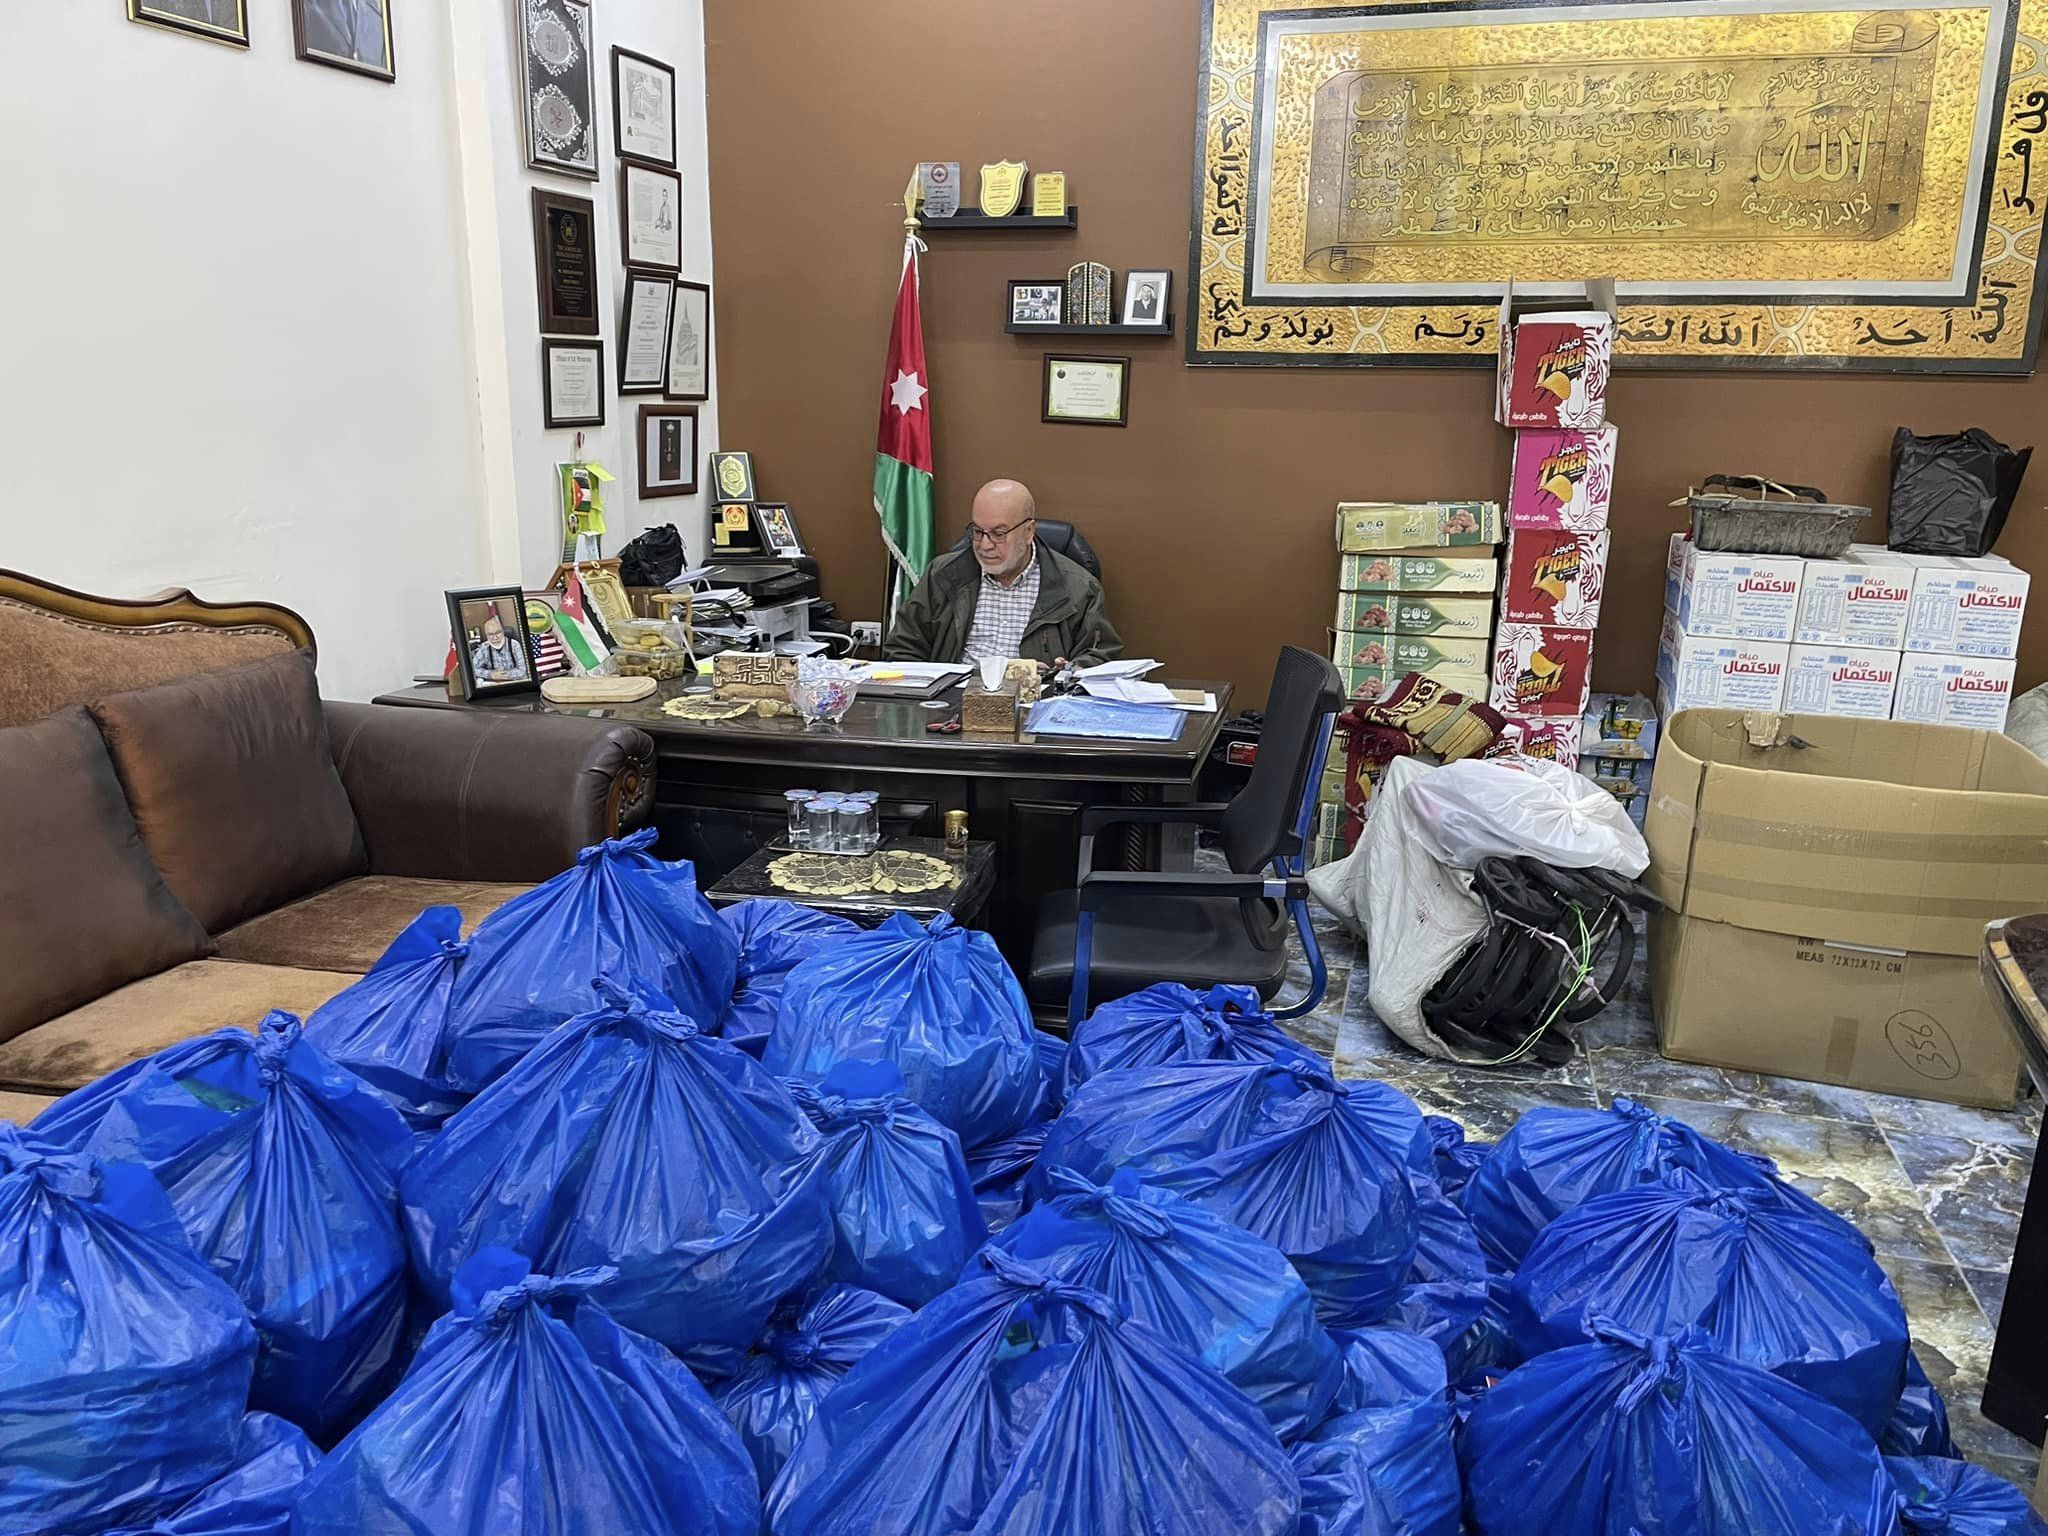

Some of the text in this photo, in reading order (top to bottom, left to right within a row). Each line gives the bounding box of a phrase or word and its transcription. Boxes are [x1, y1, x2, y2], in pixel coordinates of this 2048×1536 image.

[1757, 99, 1876, 184] الله
[1970, 275, 2018, 344] الله
[1214, 309, 1334, 347] يولد ولم
[1414, 312, 1495, 347] ولم
[1700, 312, 1760, 347] الله
[1852, 306, 1956, 346] أحد
[1556, 338, 1581, 353] تايجر
[1535, 346, 1586, 389] TIGER
[1558, 443, 1582, 457] تايجر
[1537, 451, 1588, 491] TIGER
[1552, 542, 1575, 556] تايجر
[1531, 550, 1581, 589] TIGER
[1754, 570, 1774, 578] مياه
[1737, 578, 1796, 593] الاكتمال
[1864, 577, 1886, 586] مياه
[1977, 584, 1999, 593] مياه
[1847, 586, 1909, 601] الاكتمال
[1959, 593, 2022, 608] الاكتمال
[1738, 652, 1759, 661] مياه
[1848, 659, 1870, 668] مياه
[1723, 660, 1781, 675] الاكتمال
[1832, 667, 1893, 683] الاكتمال
[1963, 668, 1985, 677] مياه
[1516, 663, 1566, 697] TIGER
[1946, 677, 2008, 692] الاكتمال
[1521, 692, 1543, 704] تايجر
[1529, 733, 1552, 745] تايجر
[1886, 962, 1902, 973] CM
[1897, 1022, 1951, 1069] 356
